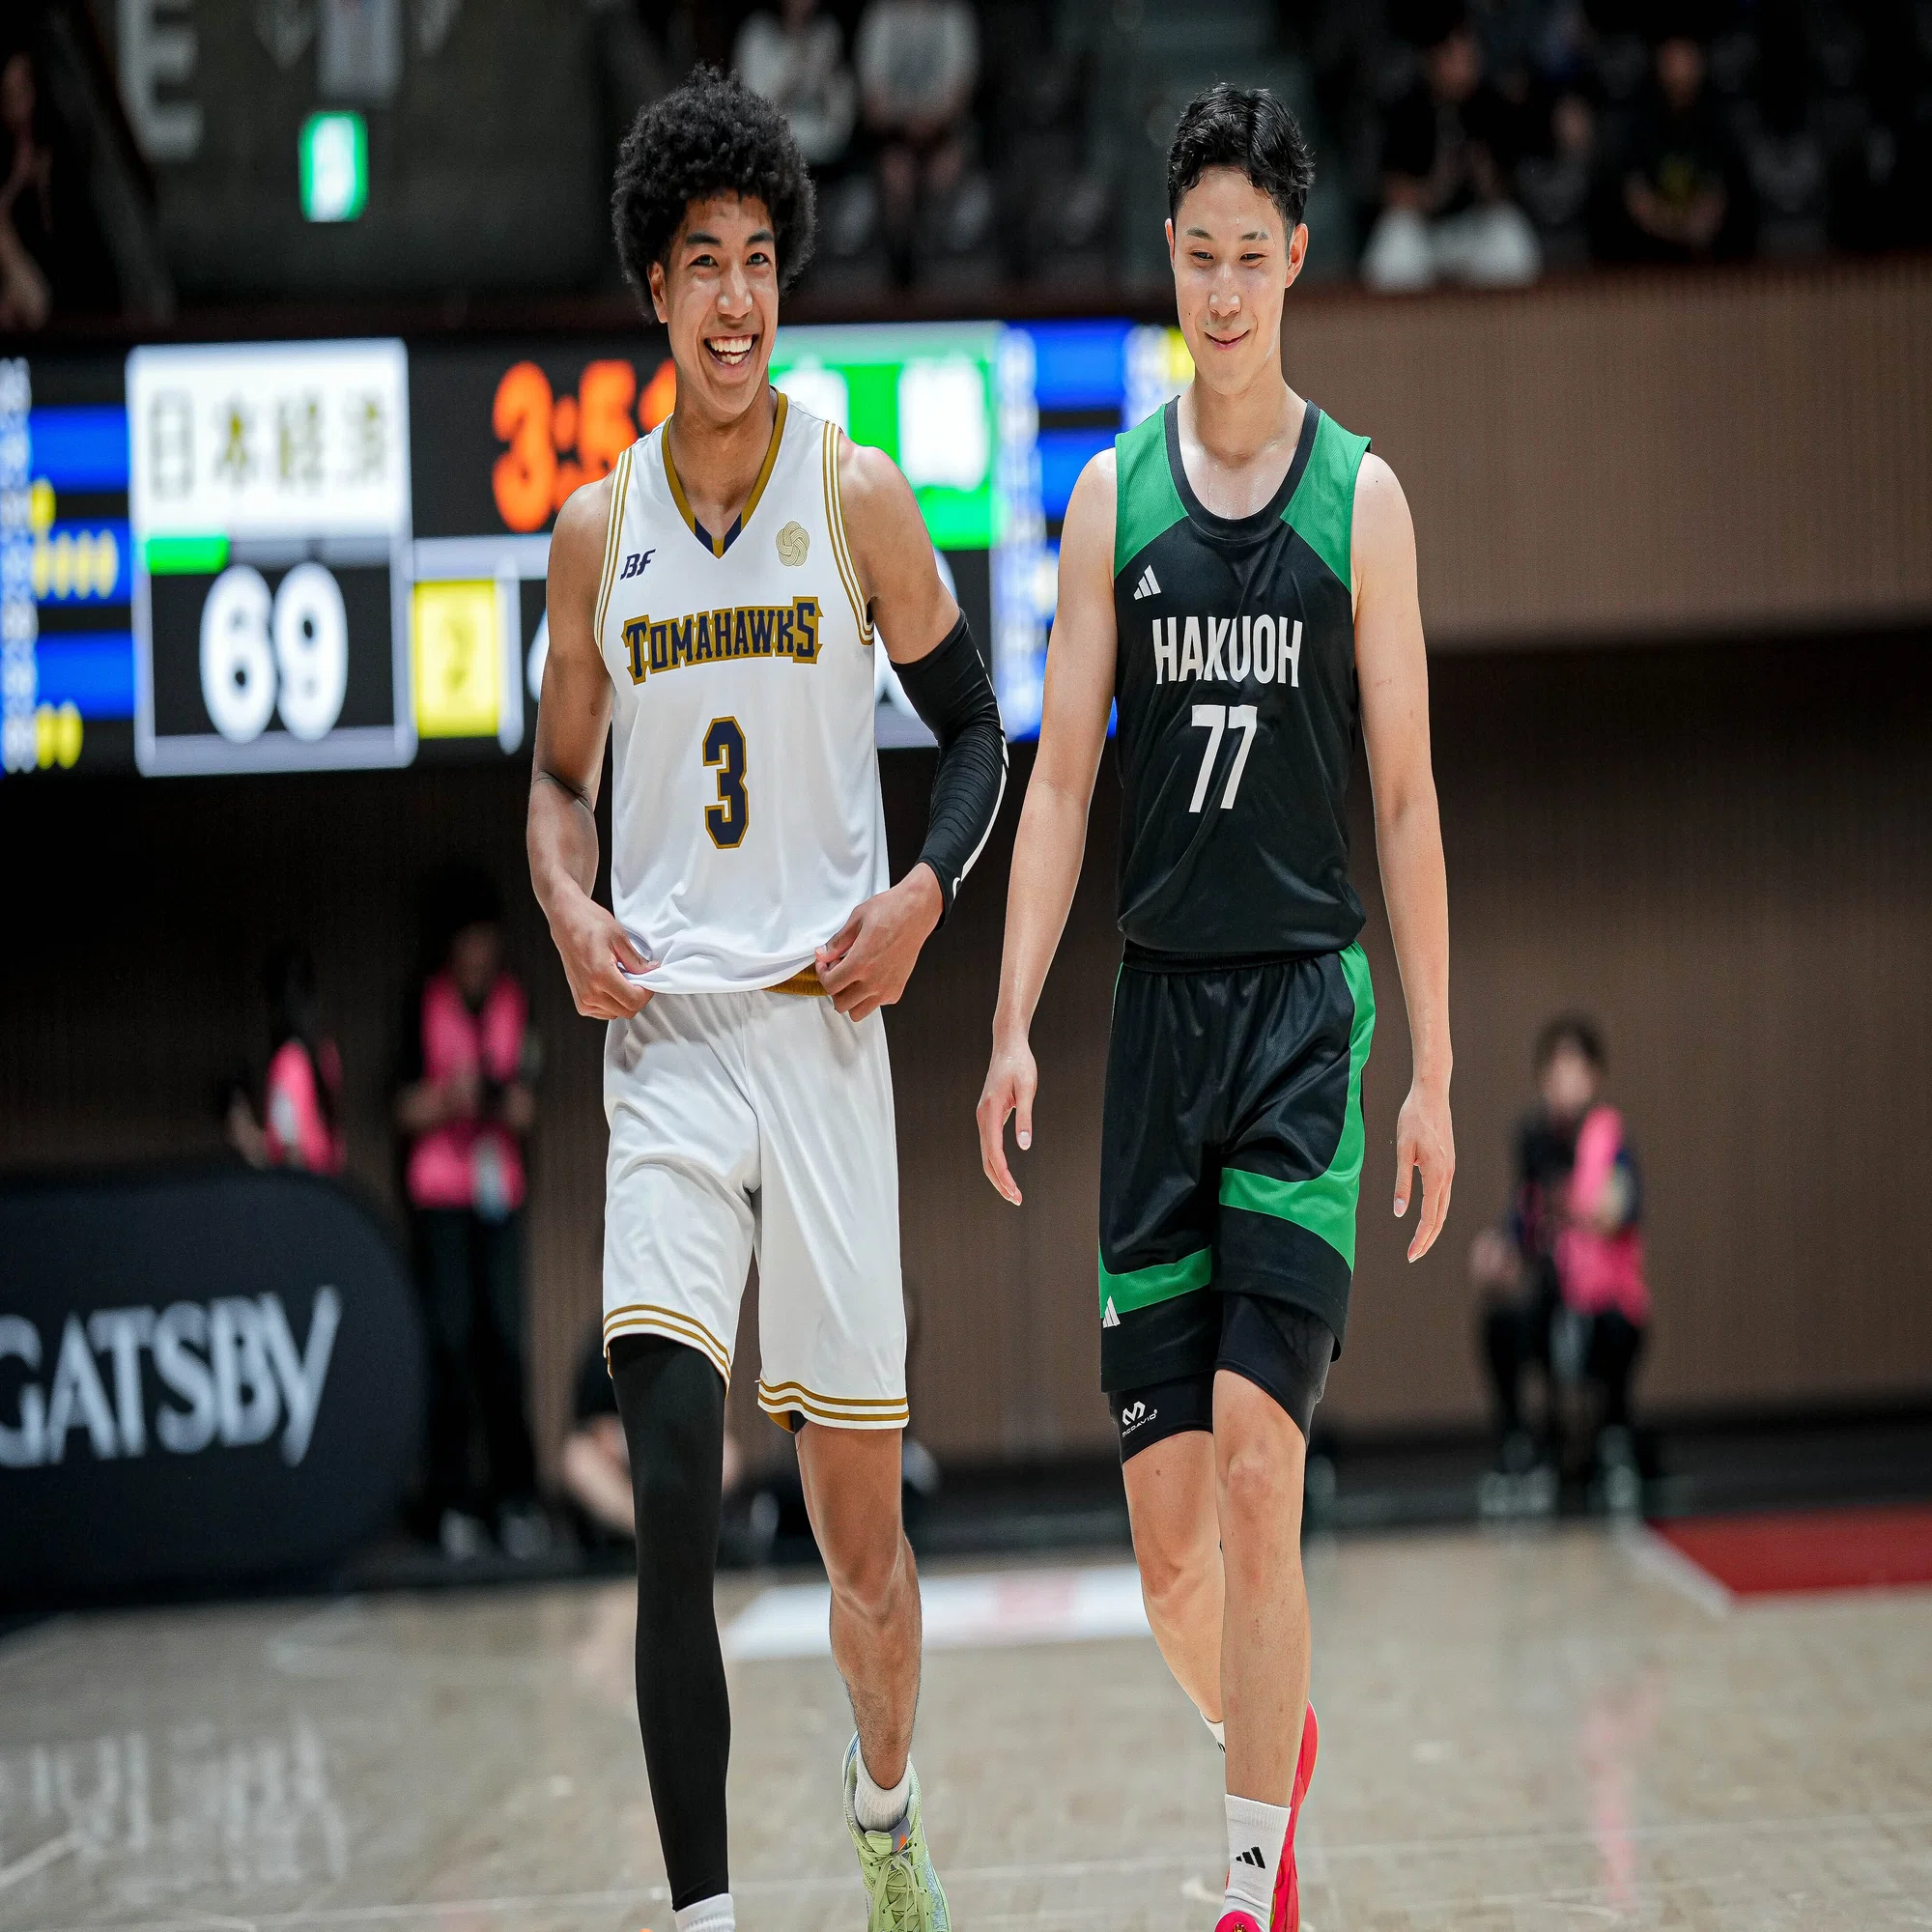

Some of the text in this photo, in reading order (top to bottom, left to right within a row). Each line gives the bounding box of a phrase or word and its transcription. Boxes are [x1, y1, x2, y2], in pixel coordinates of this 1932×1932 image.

[492, 358, 676, 533] 3:5
[619, 548, 657, 581] BF
[199, 561, 349, 745] 69
[620, 596, 824, 686] TOMAHAWKS
[1152, 613, 1303, 688] HAKUOH
[702, 716, 749, 849] 3
[1188, 704, 1258, 813] 77
[0, 1285, 343, 1469] GATSBY
